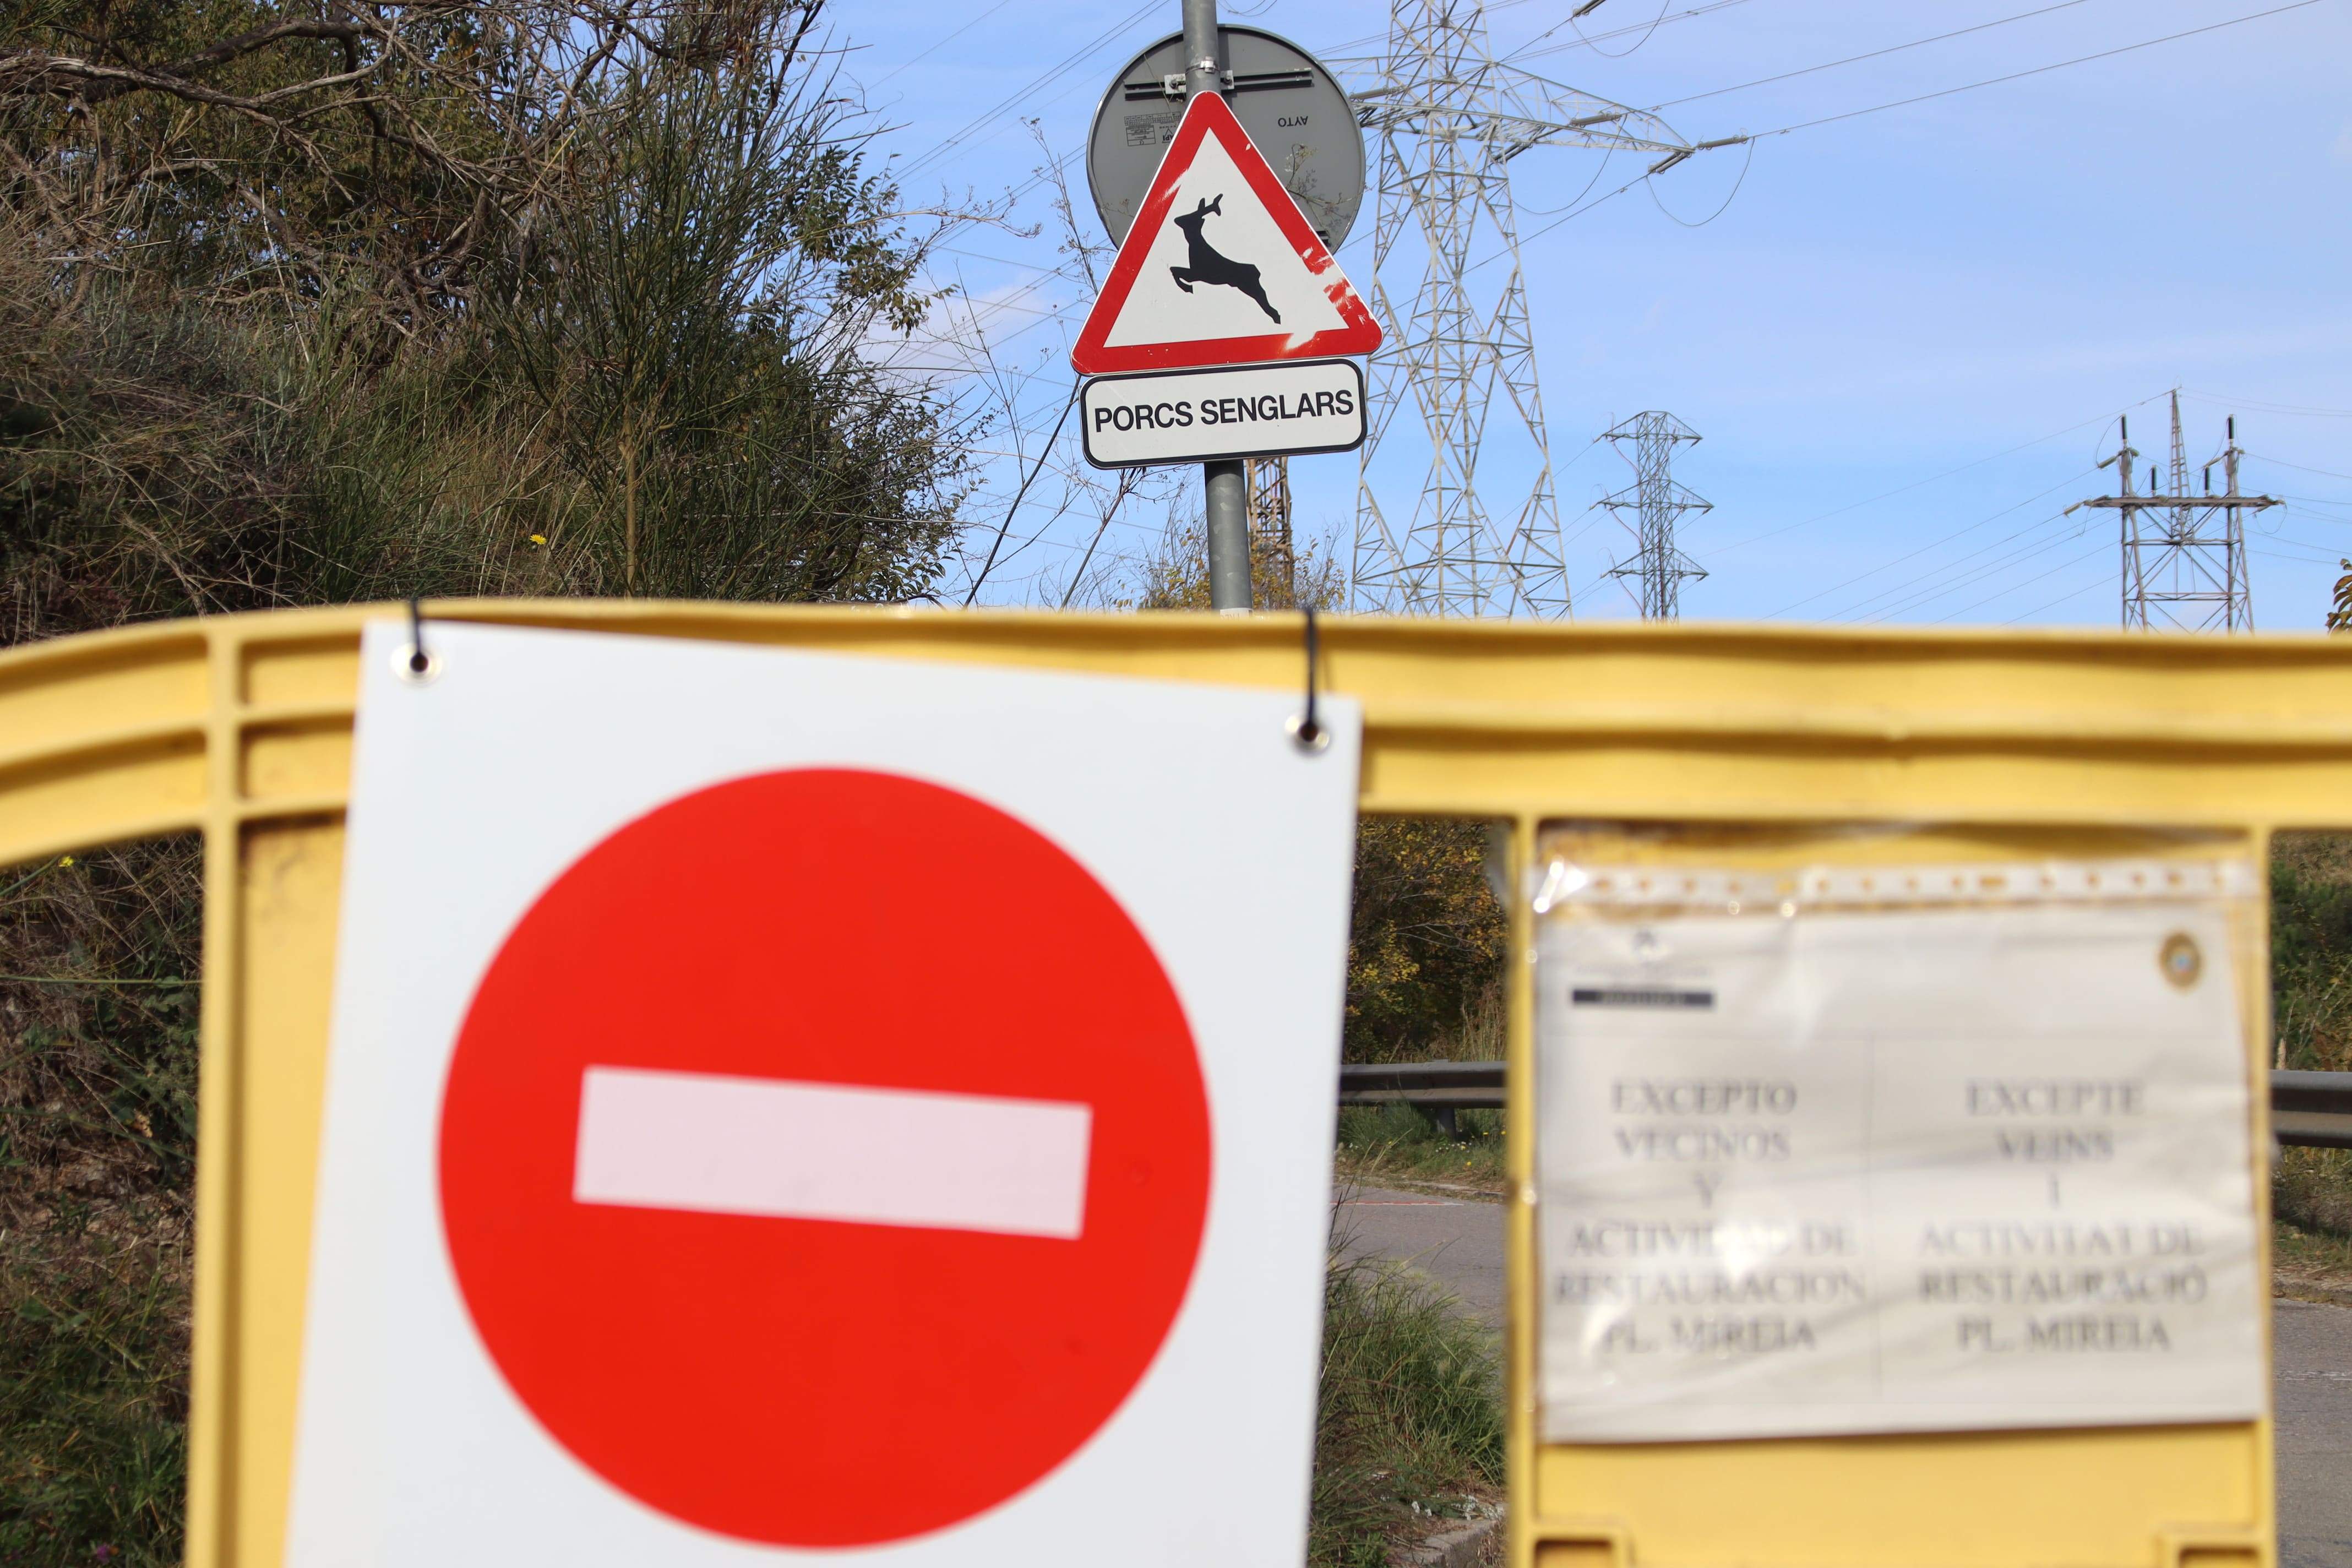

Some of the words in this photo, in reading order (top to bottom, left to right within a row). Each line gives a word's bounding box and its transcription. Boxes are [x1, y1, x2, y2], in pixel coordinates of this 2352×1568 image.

[1278, 116, 1308, 127] AYTO
[1095, 401, 1193, 432] PORCS
[1201, 389, 1354, 424] SENGLARS
[1611, 1077, 1797, 1115] EXCEPTO
[1964, 1077, 2146, 1116] EXCEPTE
[1613, 1124, 1791, 1162] VECINOS
[1693, 1170, 1723, 1209] Y
[1803, 1219, 1858, 1257] DE
[1918, 1218, 2134, 1256] ACTIVITAT
[2147, 1220, 2204, 1256] DE
[2023, 1315, 2173, 1352] MIREIA
